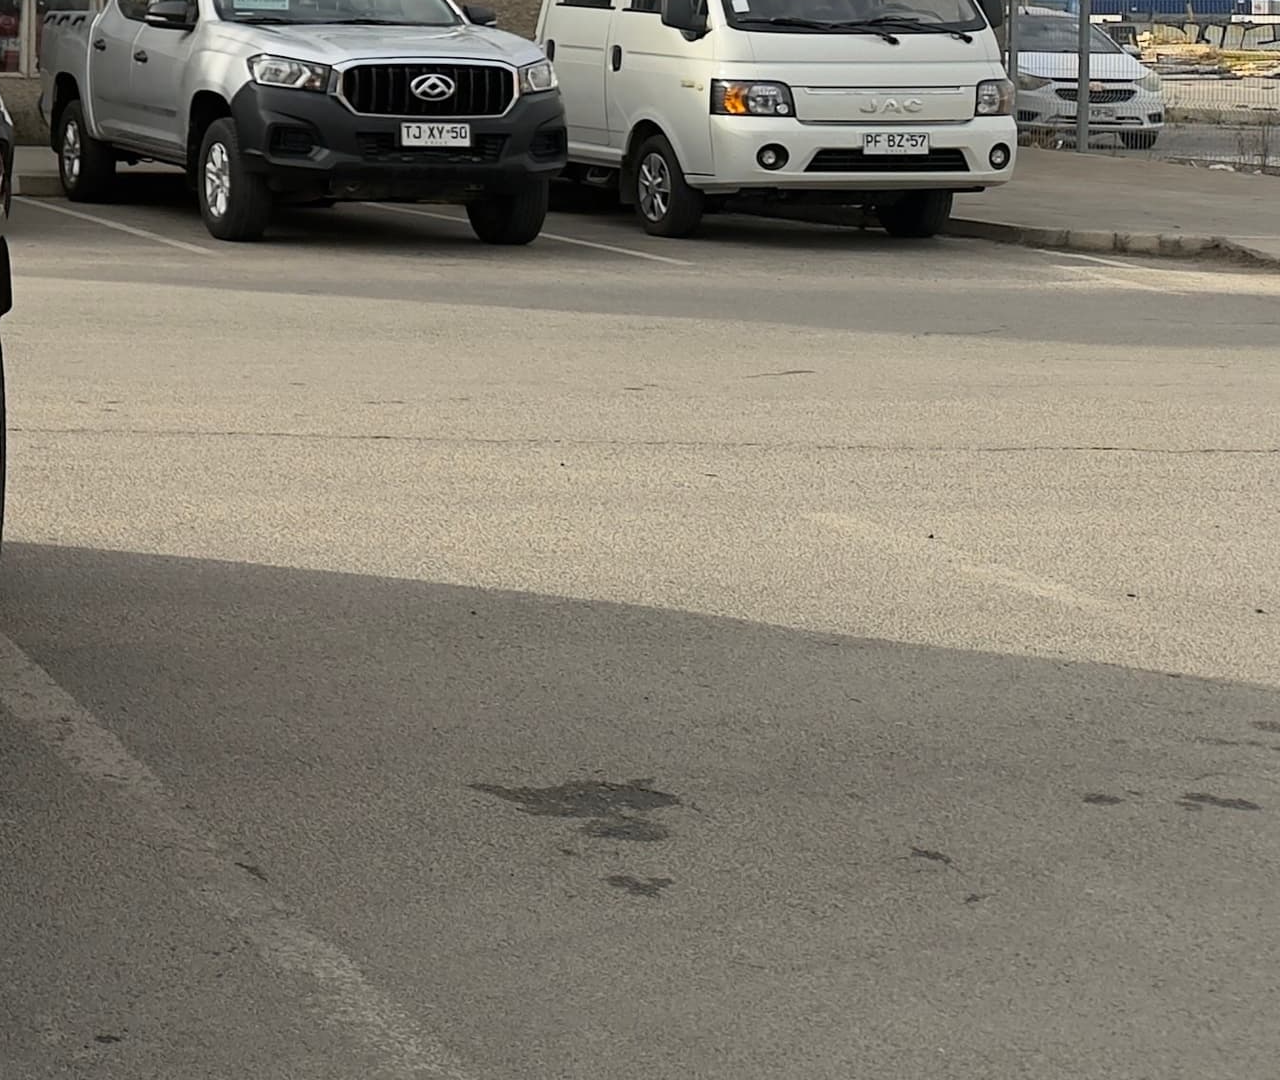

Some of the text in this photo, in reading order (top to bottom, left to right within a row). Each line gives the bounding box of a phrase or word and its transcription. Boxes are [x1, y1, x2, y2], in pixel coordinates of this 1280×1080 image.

[859, 98, 923, 114] JAC
[404, 125, 422, 139] TJ
[865, 134, 881, 147] PF
